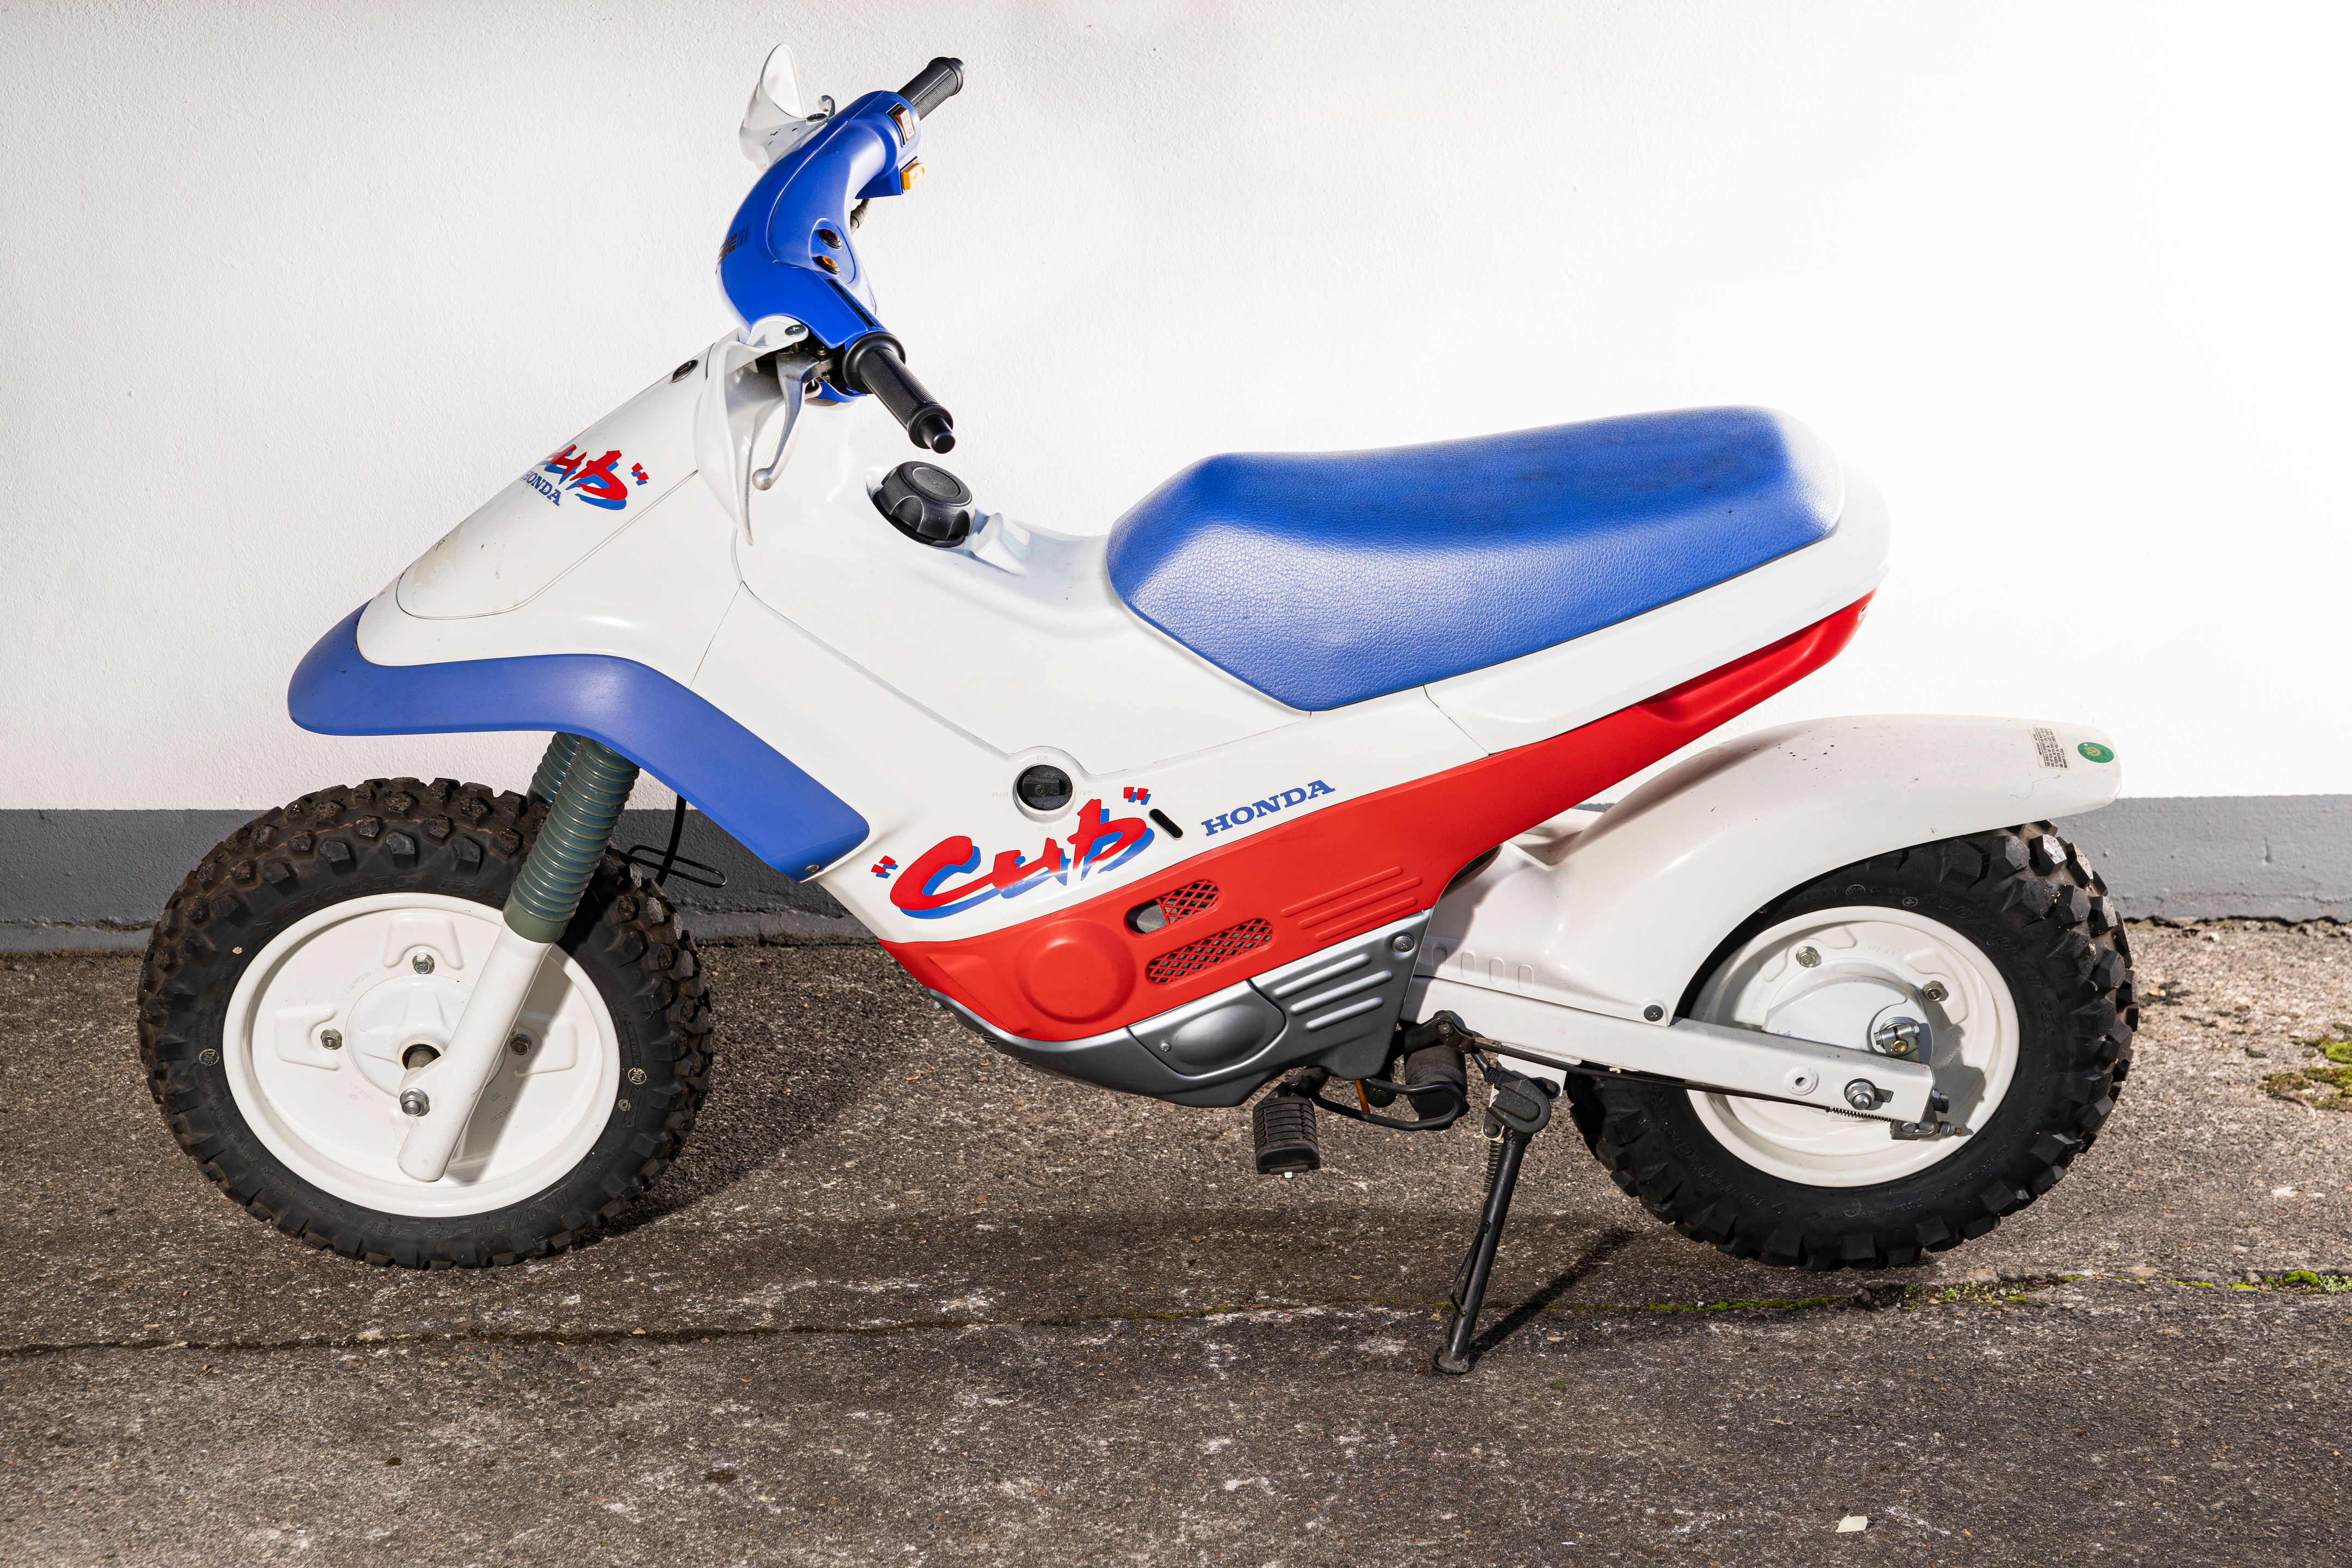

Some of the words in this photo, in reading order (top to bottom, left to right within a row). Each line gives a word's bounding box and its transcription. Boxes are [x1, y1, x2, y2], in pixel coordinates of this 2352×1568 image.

[522, 470, 561, 507] HONDA
[1200, 779, 1336, 837] HONDA
[281, 875, 420, 919] DUNLOP
[425, 1188, 572, 1240] 100/90-12
